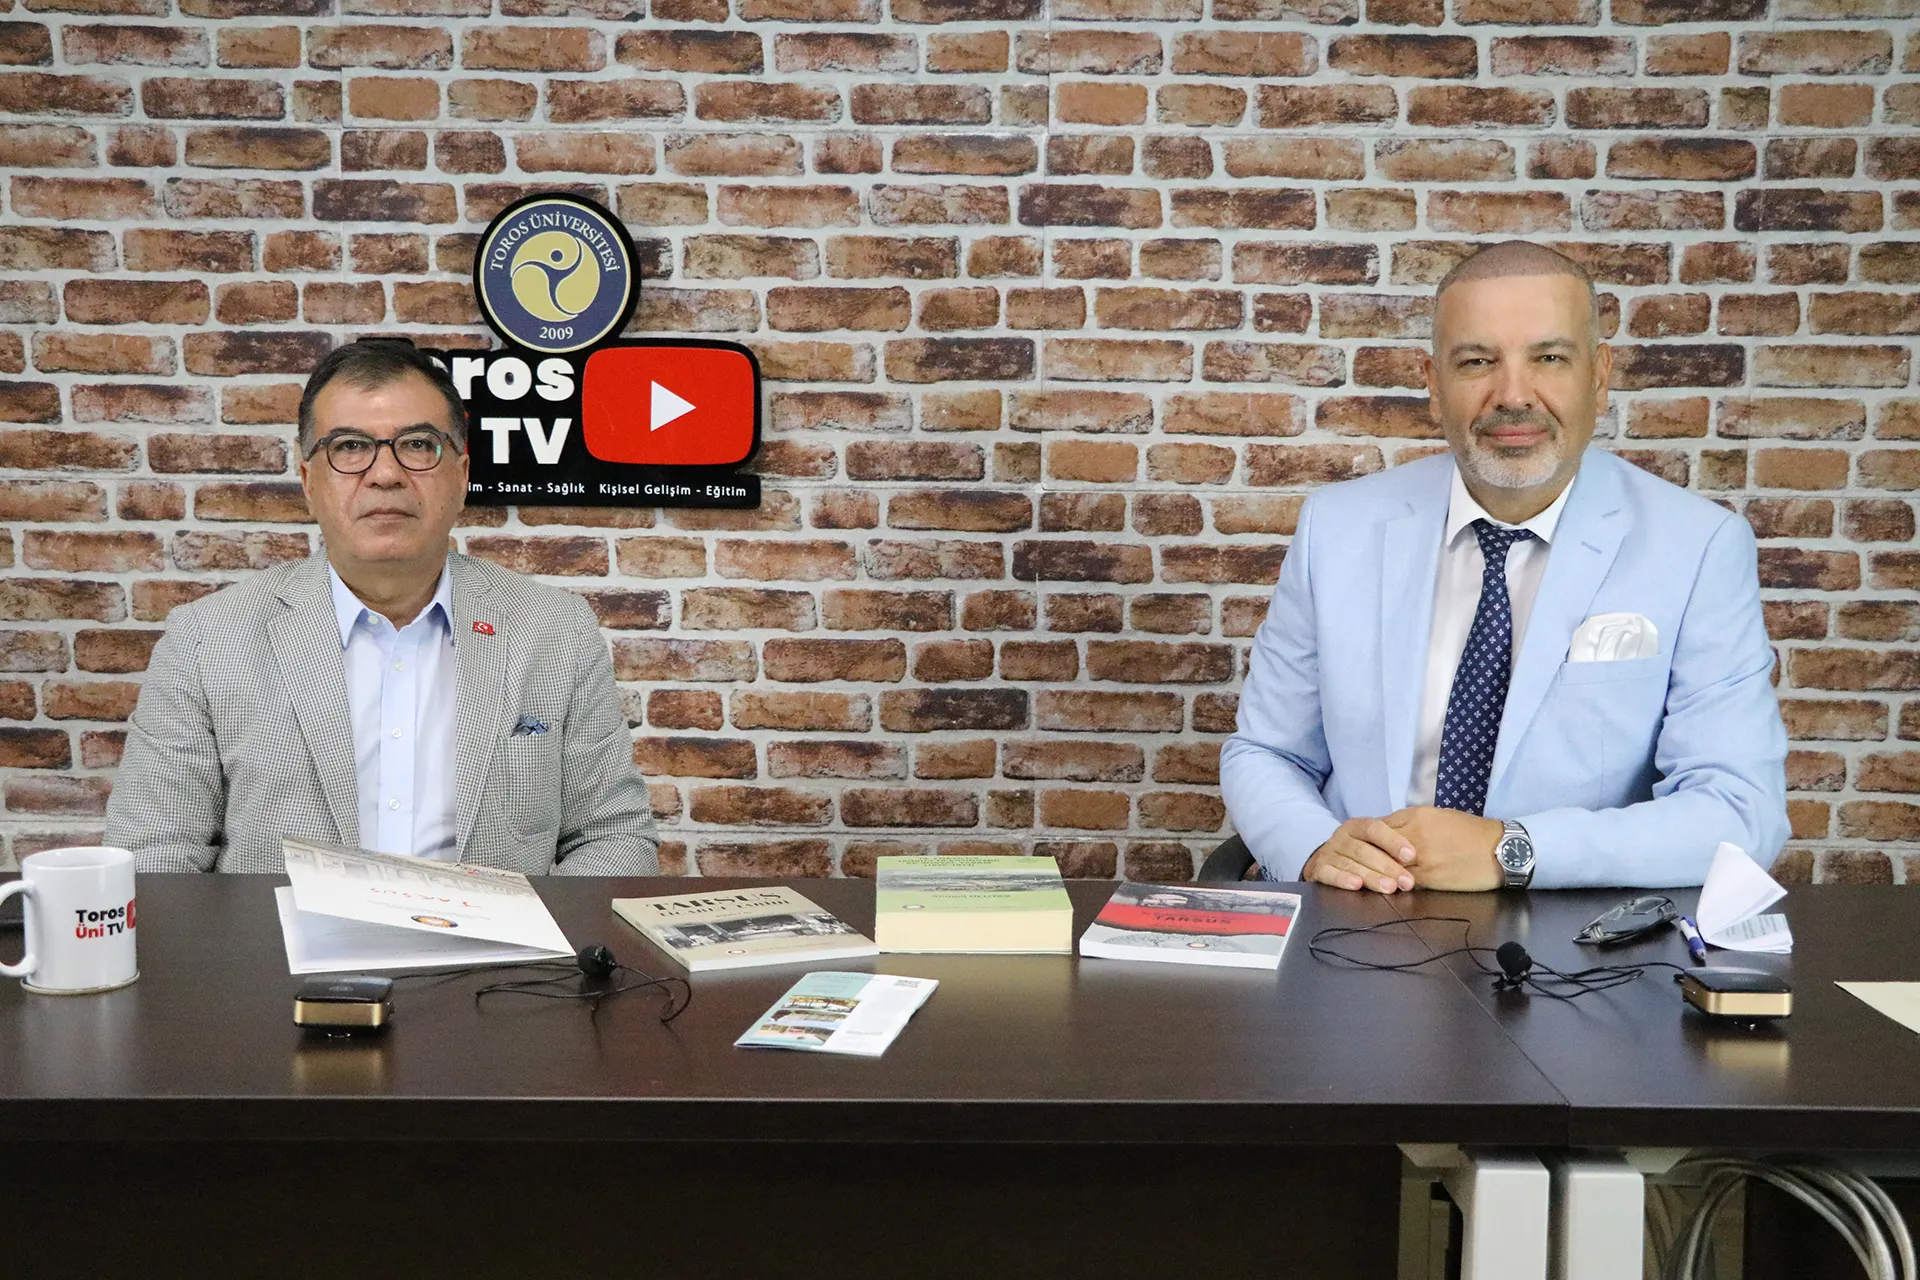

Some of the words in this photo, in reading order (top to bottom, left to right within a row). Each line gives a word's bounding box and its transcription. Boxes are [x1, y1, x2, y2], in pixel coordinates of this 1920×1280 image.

[490, 221, 529, 271] TOROS
[529, 211, 620, 272] ÜNİVERSİTESİ
[539, 326, 574, 340] 2009
[430, 356, 575, 401] ros
[480, 417, 573, 465] TV
[497, 481, 533, 493] Sanat
[547, 482, 585, 496] Sağlık
[599, 483, 640, 496] Kişisel
[644, 484, 691, 497] Gelişim
[706, 485, 747, 498] Eğitim
[75, 906, 125, 923] Toros
[75, 923, 105, 939] Üni
[107, 921, 125, 936] TV
